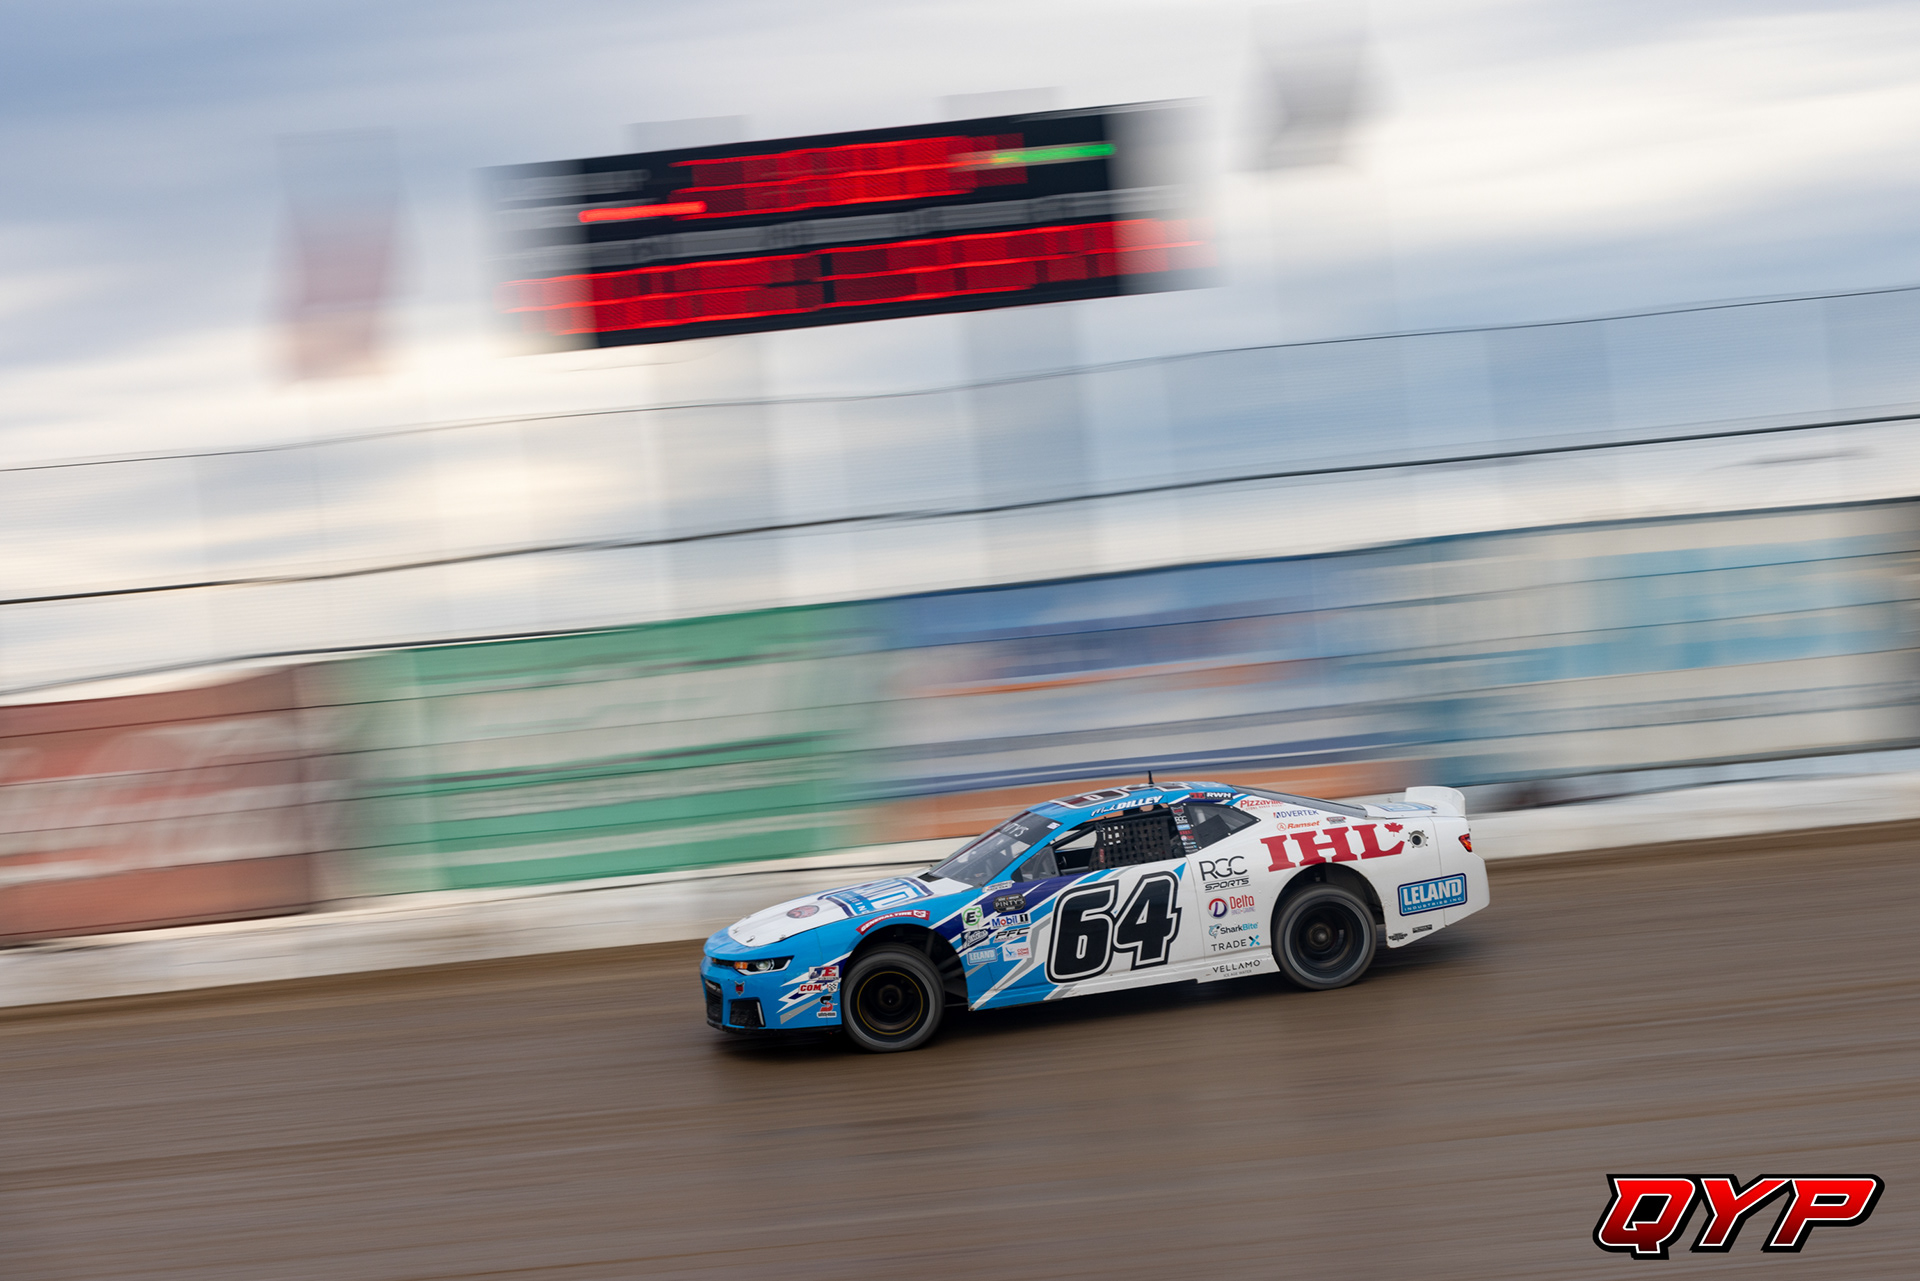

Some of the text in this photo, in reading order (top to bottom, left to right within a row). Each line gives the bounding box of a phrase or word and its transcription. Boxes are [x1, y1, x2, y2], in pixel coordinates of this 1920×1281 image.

[1115, 795, 1163, 811] DILLEY
[1287, 820, 1320, 829] Ramset
[1260, 823, 1405, 872] IHL
[1199, 856, 1248, 881] RGC
[1204, 877, 1249, 891] SPORTS
[1403, 878, 1463, 906] LELAND
[1229, 894, 1255, 910] Delta
[1404, 900, 1449, 912] INDUSTRIES
[861, 914, 895, 932] GENERAL
[991, 915, 1018, 927] Mobil
[1046, 871, 1182, 983] 64
[995, 926, 1030, 939] PFC
[1220, 922, 1258, 935] SharkBite
[968, 950, 995, 961] LELAND
[1212, 959, 1261, 973] VELLAMO
